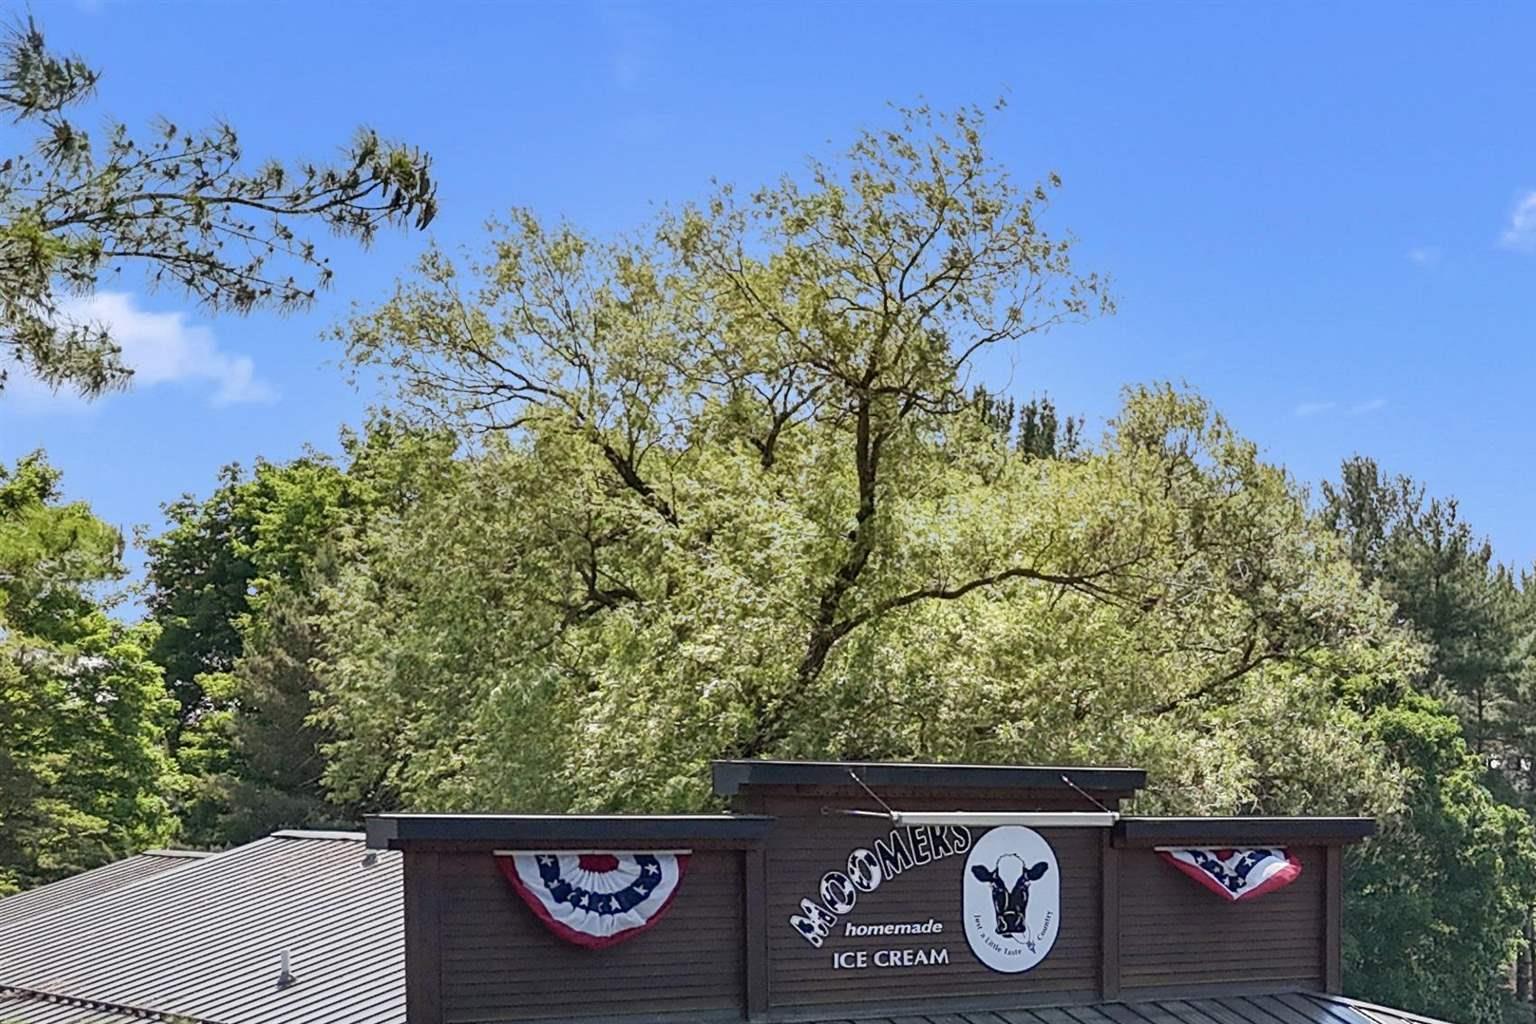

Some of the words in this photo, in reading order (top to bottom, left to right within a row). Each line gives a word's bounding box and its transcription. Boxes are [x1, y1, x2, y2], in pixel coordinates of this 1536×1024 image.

[790, 825, 972, 948] MOOMERS
[845, 919, 943, 936] homemade
[833, 952, 867, 969] ICE
[873, 949, 949, 967] CREAM
